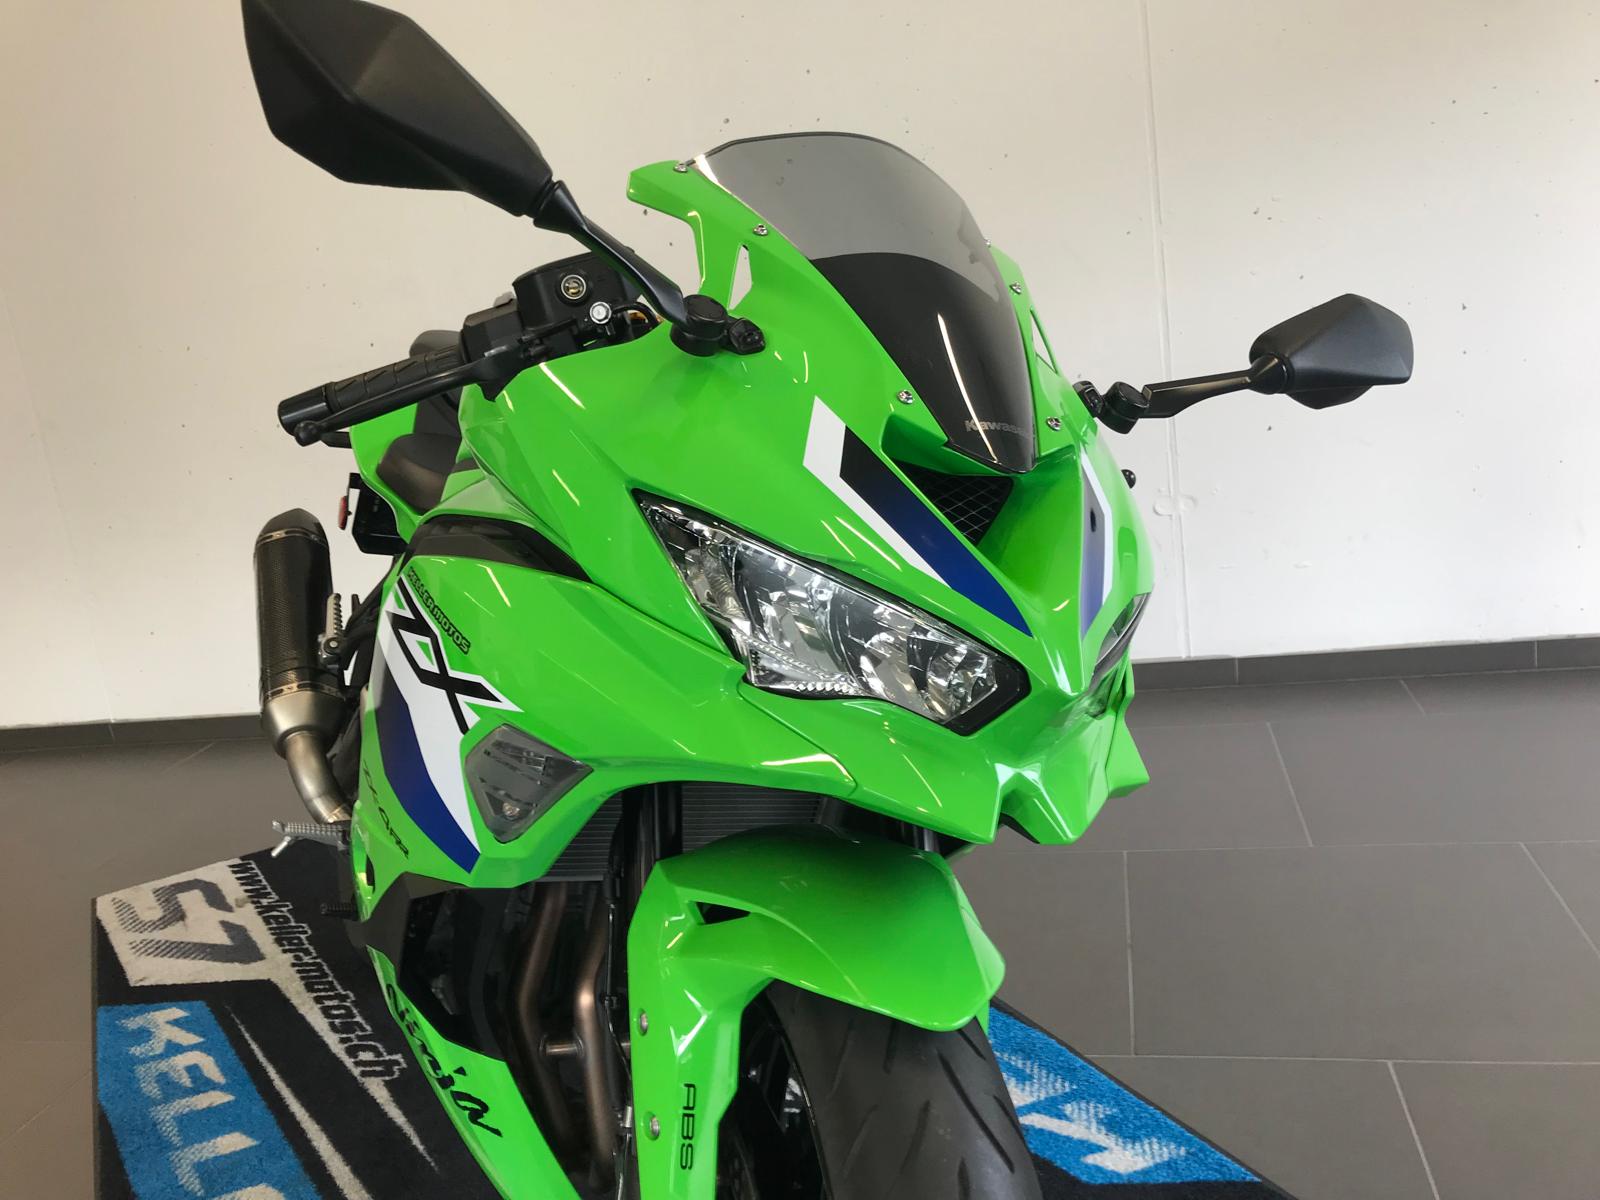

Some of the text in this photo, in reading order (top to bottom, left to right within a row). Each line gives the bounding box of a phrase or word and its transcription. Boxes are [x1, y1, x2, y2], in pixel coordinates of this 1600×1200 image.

[230, 858, 408, 1082] www.keller-motos.ch
[386, 983, 503, 1138] Ninja
[680, 1083, 696, 1171] ABS
